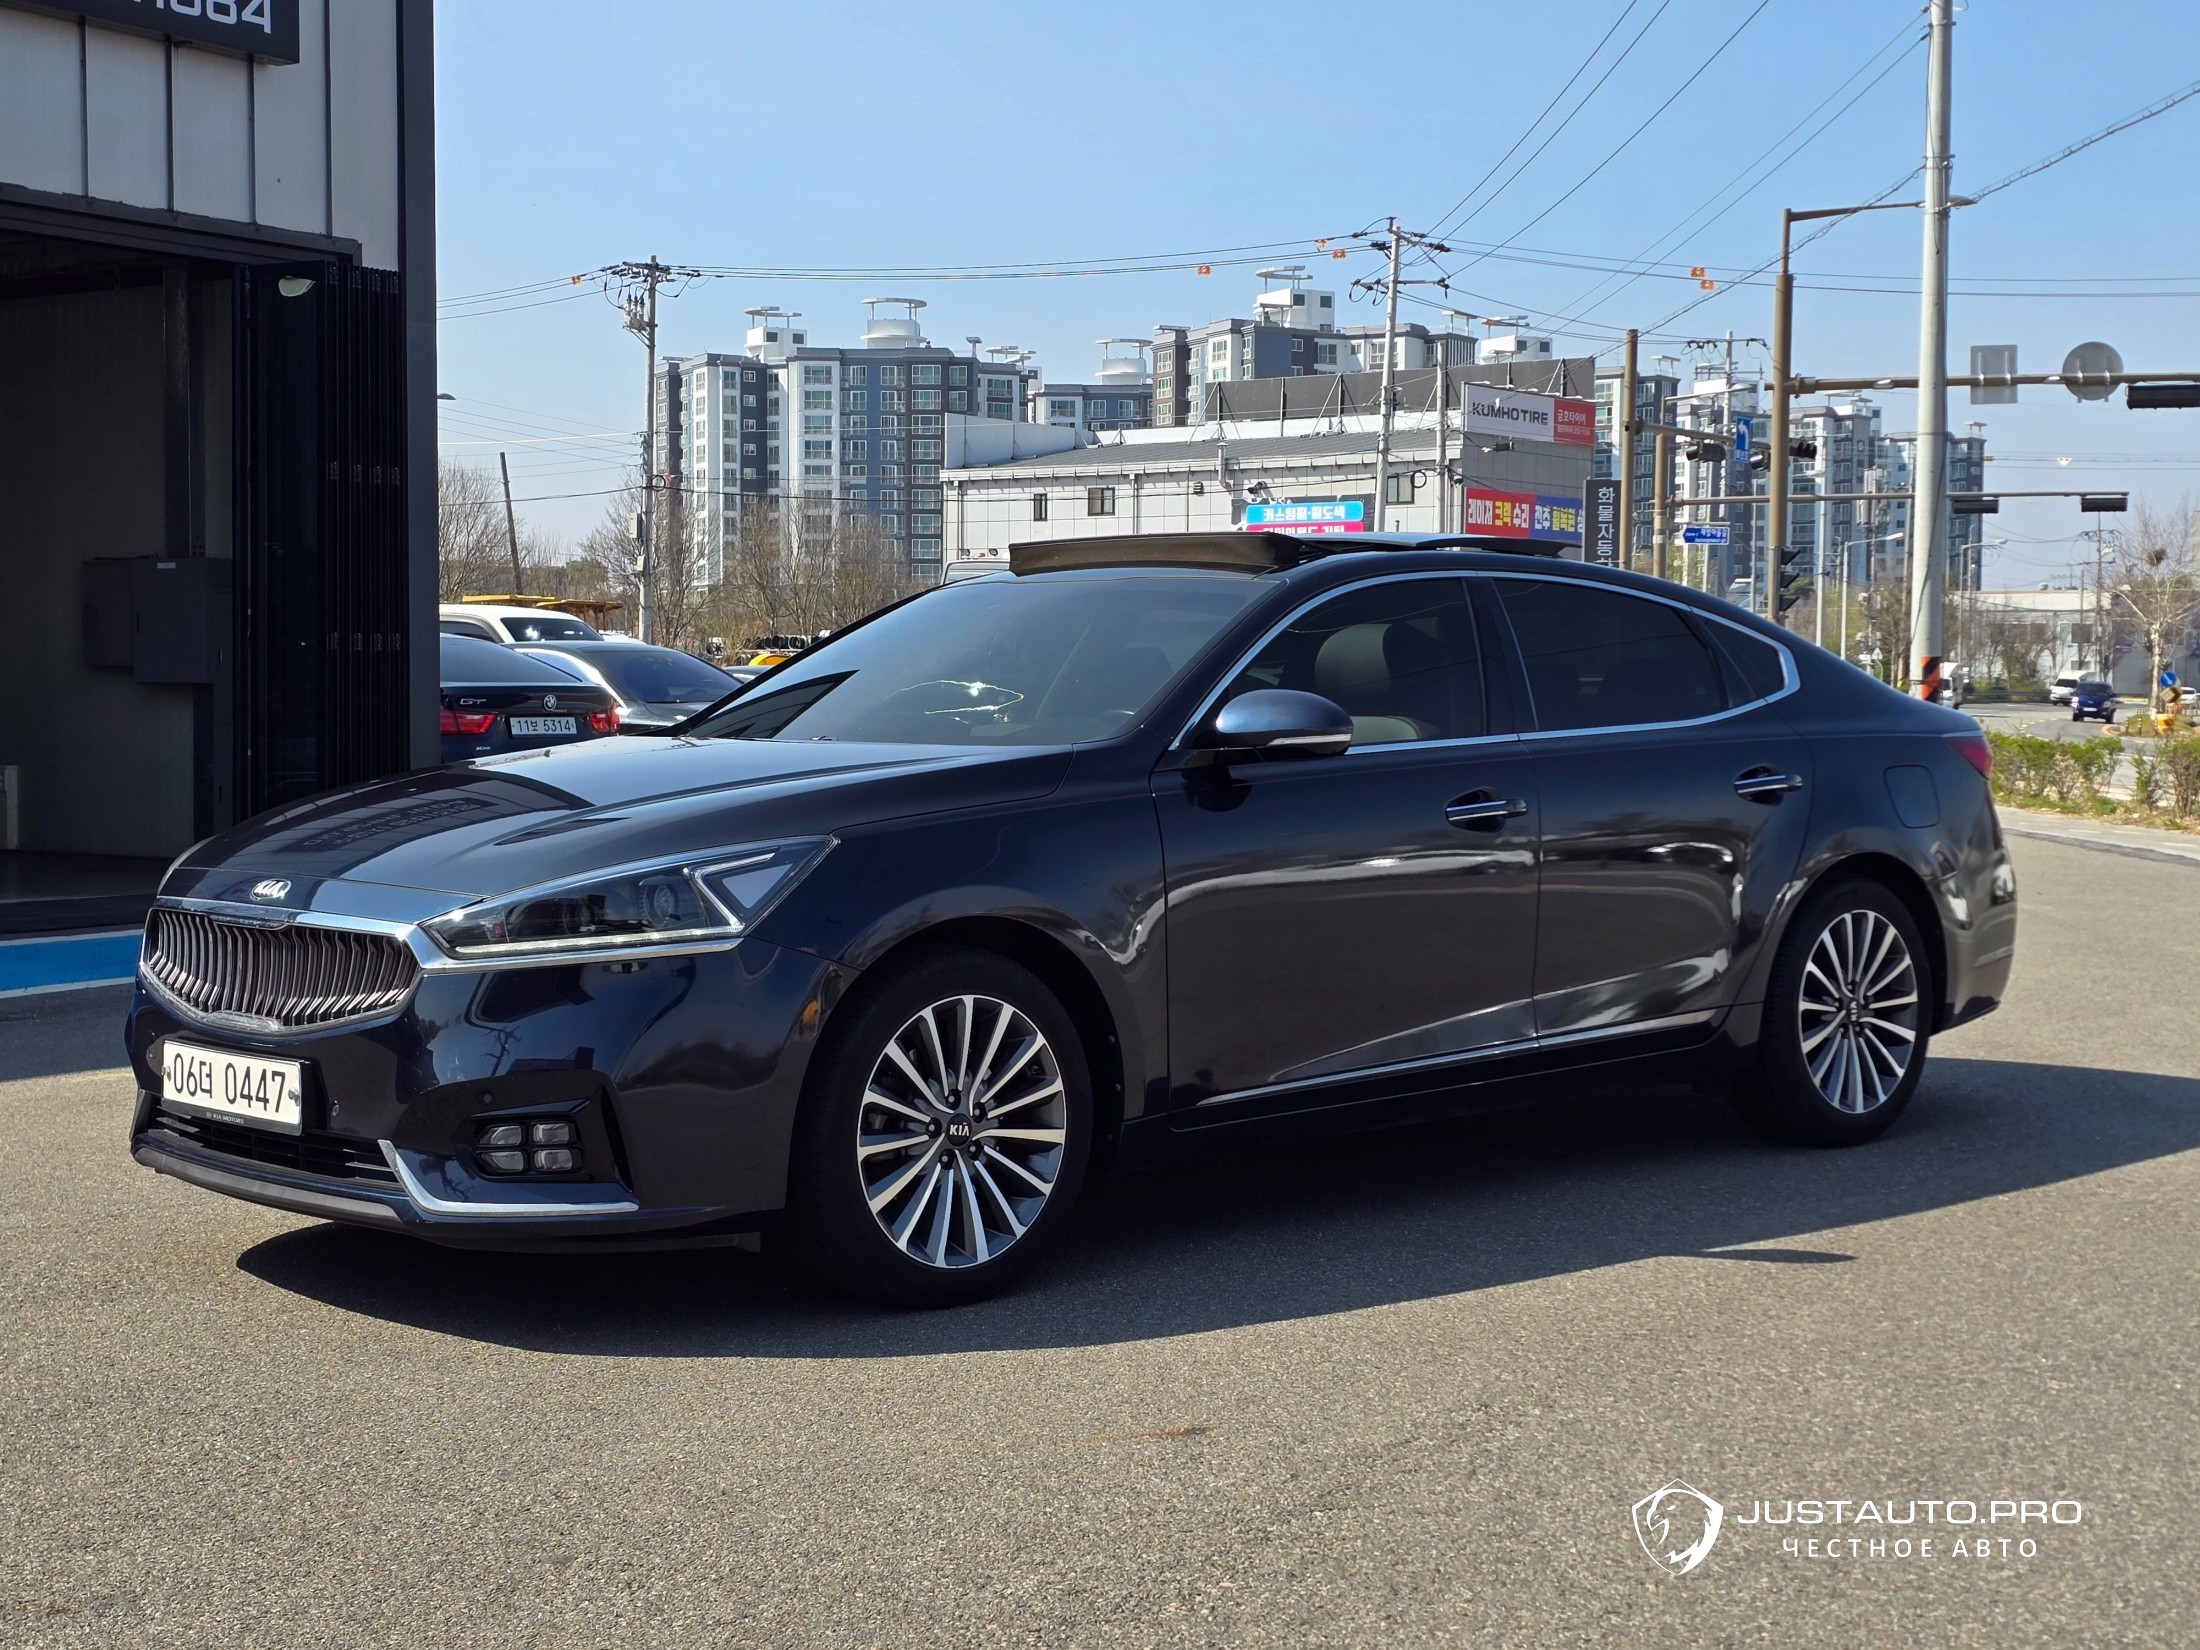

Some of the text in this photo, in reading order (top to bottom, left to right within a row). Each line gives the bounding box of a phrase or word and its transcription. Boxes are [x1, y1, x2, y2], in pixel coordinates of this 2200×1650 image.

[1557, 409, 1586, 425] 금호타이어
[1468, 498, 1493, 525] 레이저
[1494, 501, 1512, 527] 크랙
[1513, 502, 1530, 529] 수리
[1534, 505, 1551, 531] 전주
[516, 719, 571, 732] 11보 5314
[173, 1053, 286, 1113] 06더 0447
[222, 1115, 244, 1125] MOTORS
[950, 1125, 969, 1136] KIA
